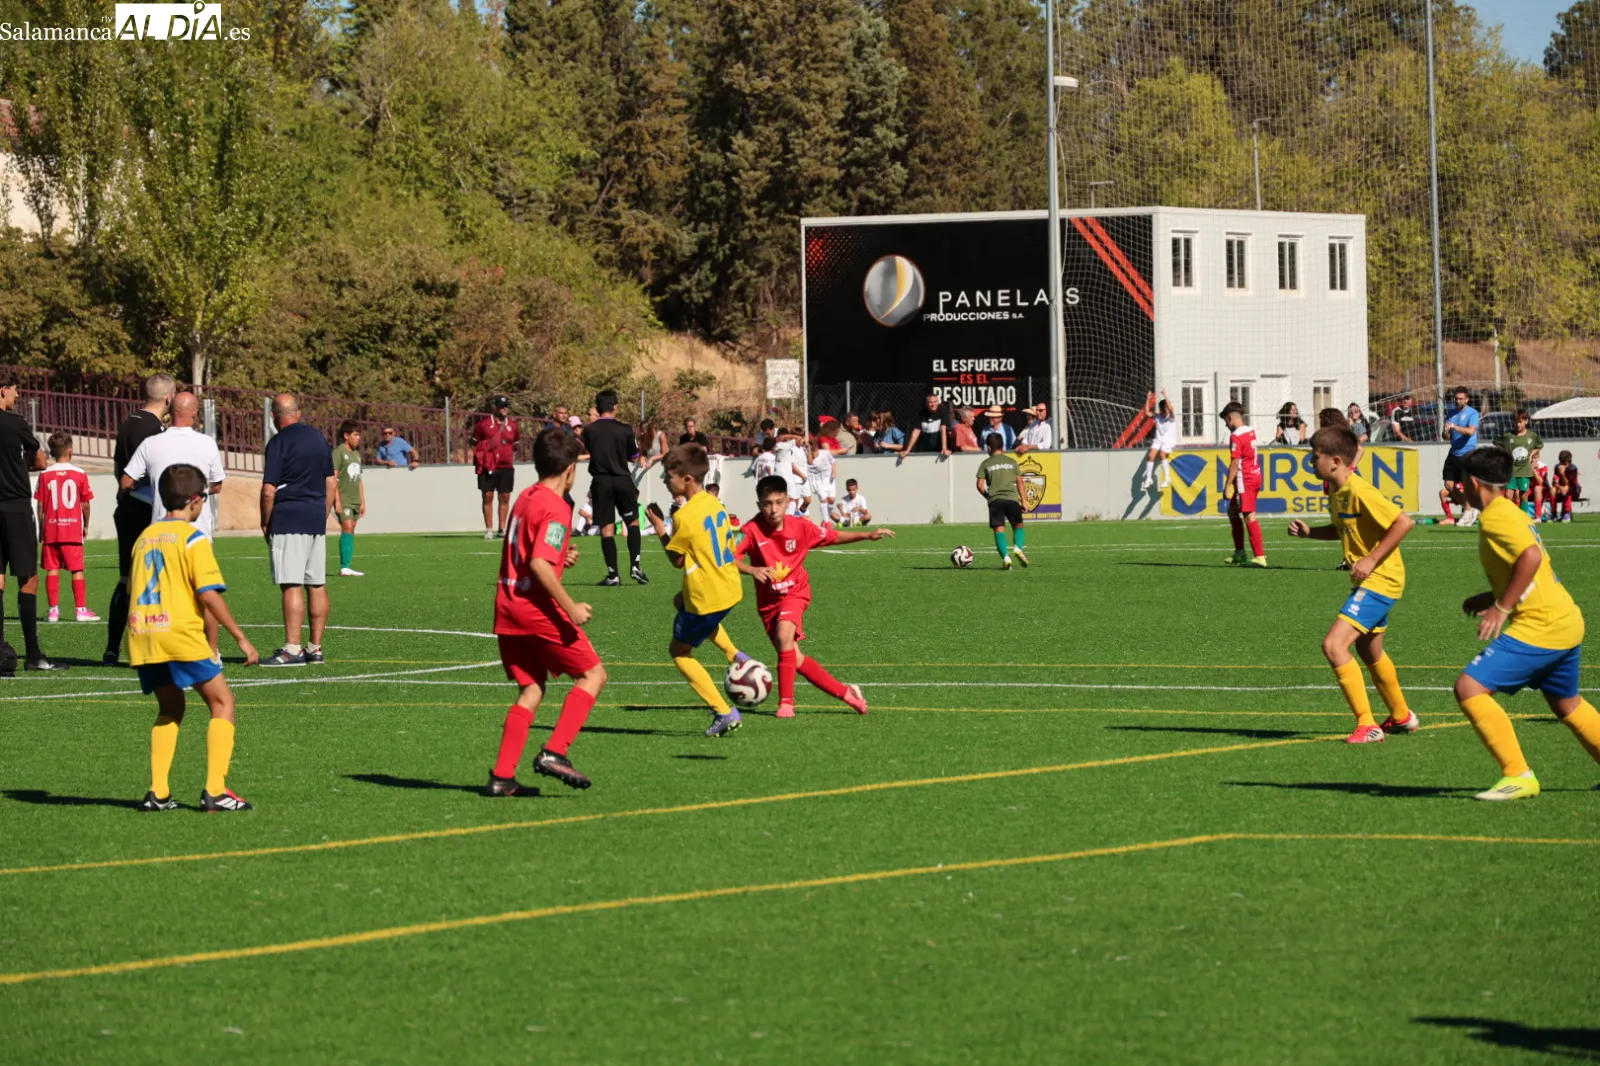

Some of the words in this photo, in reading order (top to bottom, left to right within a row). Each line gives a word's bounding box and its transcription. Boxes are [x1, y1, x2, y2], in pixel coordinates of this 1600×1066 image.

[938, 287, 1080, 315] PANELAS
[923, 311, 1010, 322] PRODUCCIONES
[932, 359, 948, 372] EL
[951, 358, 1016, 372] ESFUERZO
[960, 373, 974, 384] ES
[976, 373, 989, 384] EL
[932, 385, 1017, 406] RESULTADO
[1216, 451, 1404, 493] IRSN
[47, 478, 77, 511] 10
[704, 511, 735, 568] 12
[137, 549, 164, 605] 2
